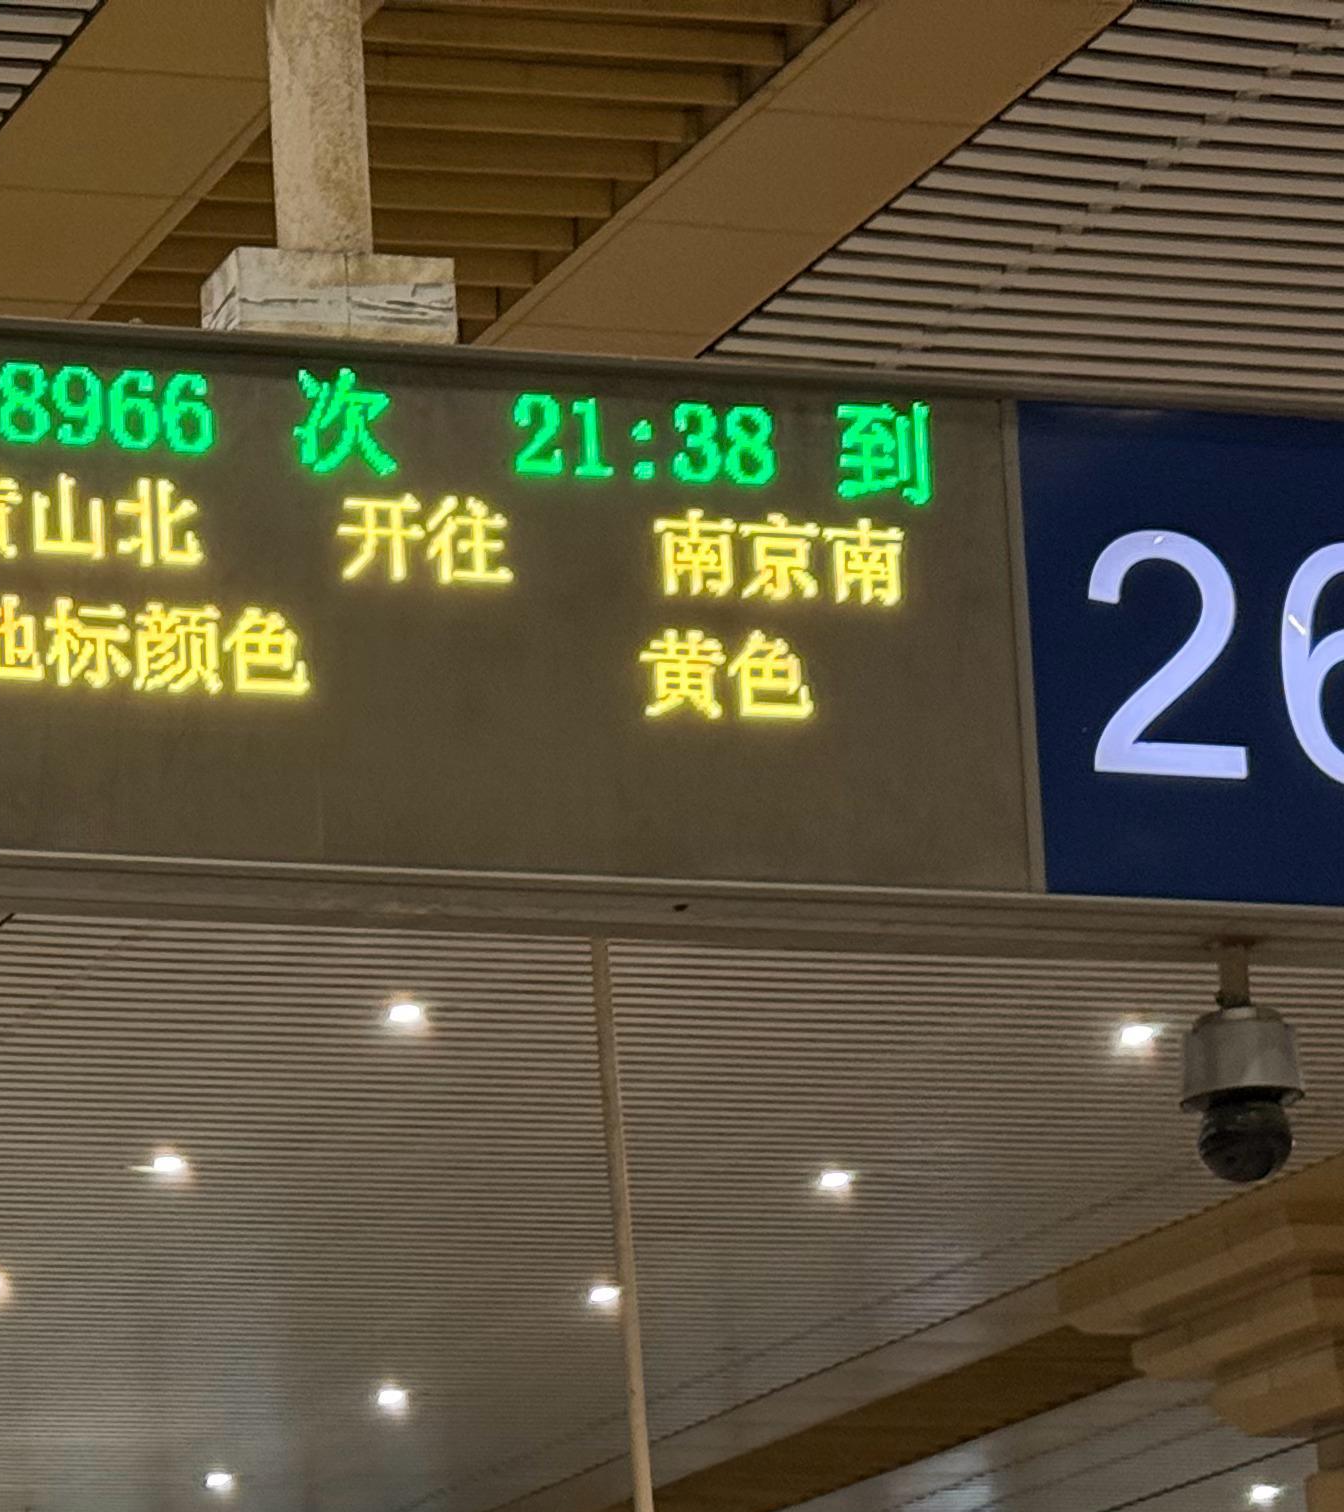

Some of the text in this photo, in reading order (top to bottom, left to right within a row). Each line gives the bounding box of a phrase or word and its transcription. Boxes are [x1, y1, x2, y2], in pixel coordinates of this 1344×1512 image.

[291, 366, 398, 479] 次
[512, 392, 778, 489] 21:38
[835, 400, 934, 506] 到
[336, 492, 515, 586] 开往
[652, 507, 906, 607] 南京南
[638, 627, 816, 721] 黄色
